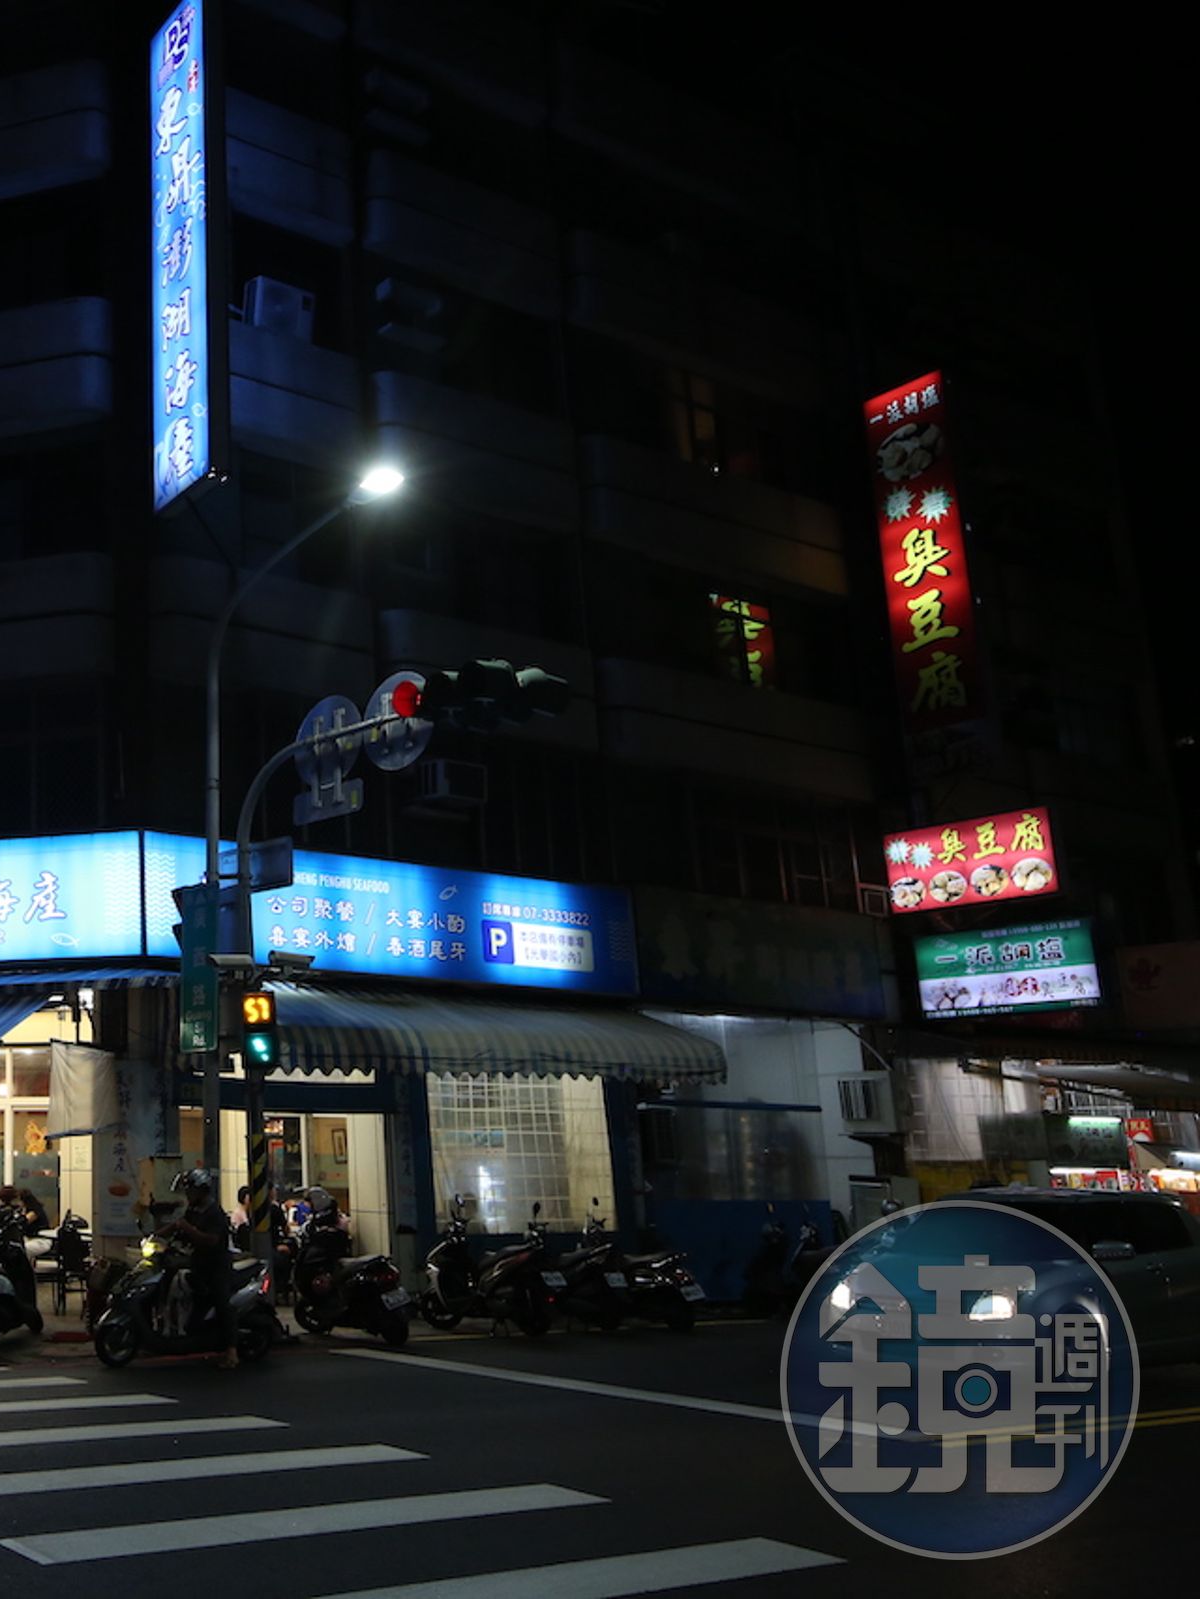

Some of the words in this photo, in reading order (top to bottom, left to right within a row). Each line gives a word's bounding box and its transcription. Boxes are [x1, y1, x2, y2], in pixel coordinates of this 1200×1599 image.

[892, 527, 969, 713] 臭豆腐
[937, 813, 1045, 865] 臭豆腐
[353, 877, 391, 894] SEAFOOD
[266, 895, 356, 923] 公司聚餐
[385, 908, 466, 934] 大宴小酌
[522, 906, 591, 927] 07-3333822
[386, 935, 467, 962] 春酒尾牙
